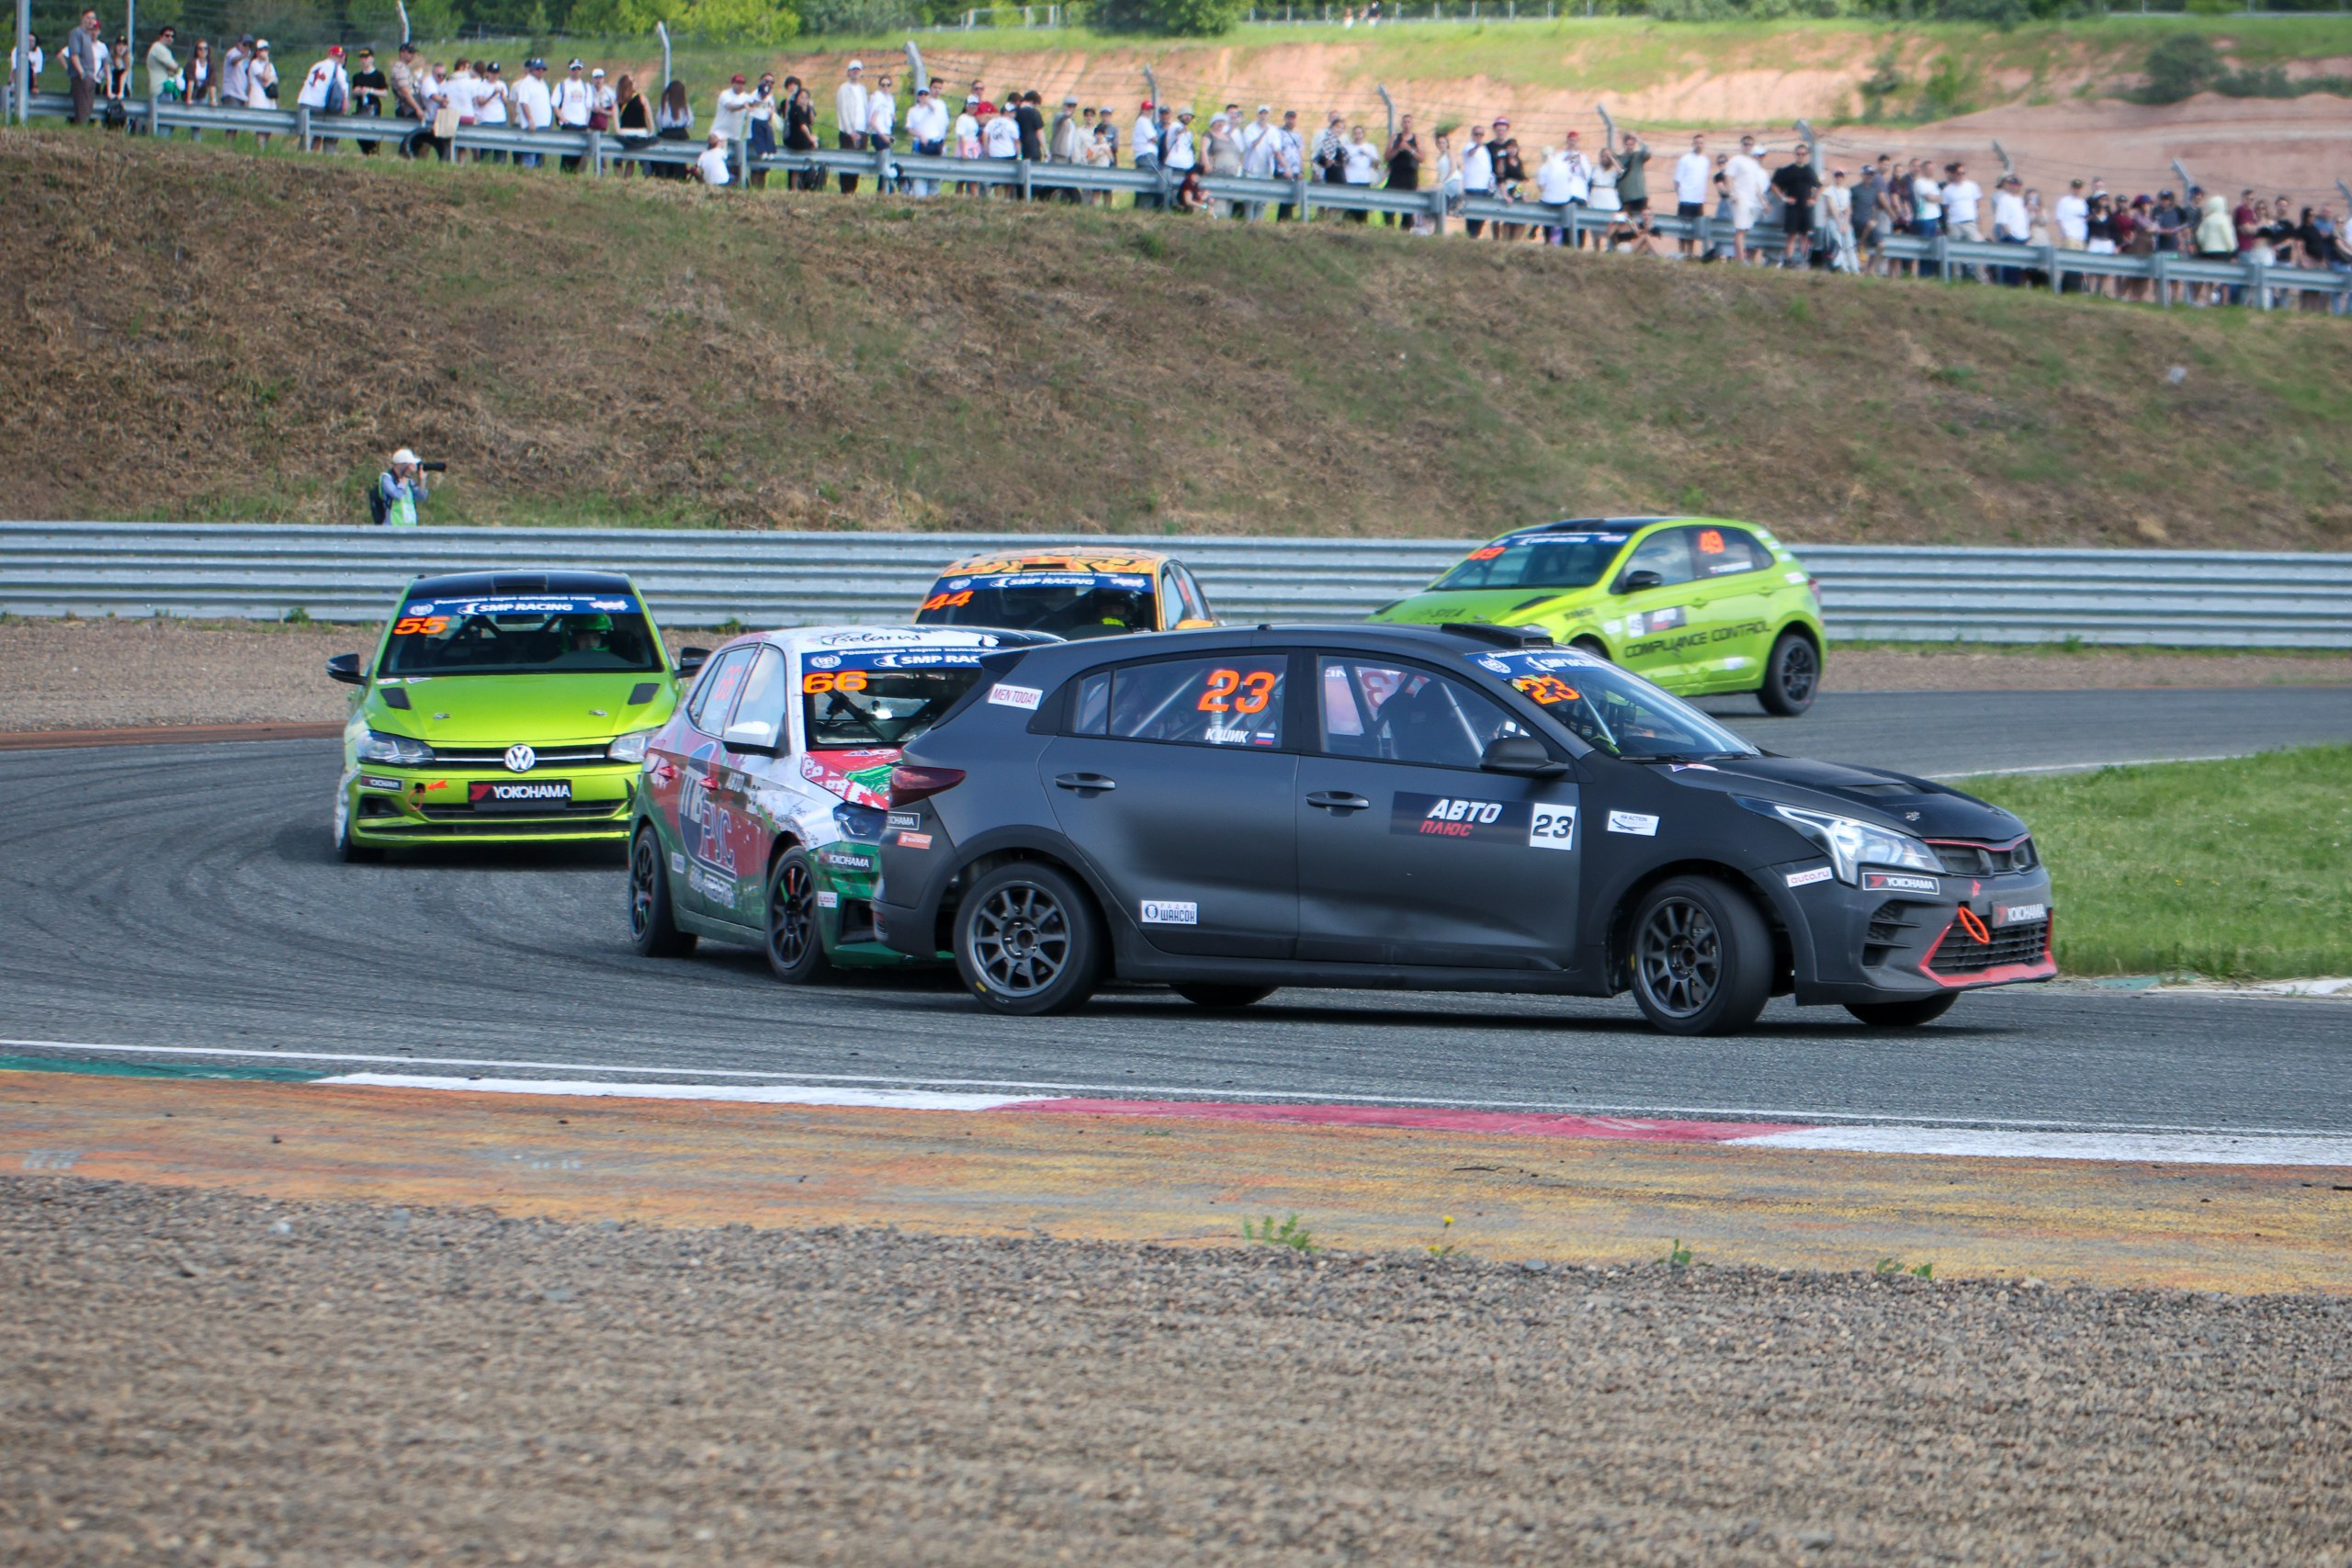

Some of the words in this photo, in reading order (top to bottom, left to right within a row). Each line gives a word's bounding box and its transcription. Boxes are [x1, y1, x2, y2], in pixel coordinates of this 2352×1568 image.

[479, 604, 514, 612] SMP
[922, 591, 975, 610] 44
[393, 616, 450, 635] 55
[1712, 621, 1771, 642] CONTROL
[901, 655, 944, 664] SMP
[945, 655, 980, 663] RAC
[803, 671, 868, 694] 66
[1518, 676, 1581, 705] 23
[993, 688, 1012, 701] MEN
[1012, 691, 1039, 705] TODAY
[1197, 670, 1276, 714] 23
[493, 785, 571, 799] YOKOHAMA
[1427, 798, 1503, 824] АВТО
[1419, 819, 1474, 837] ПЛЮС
[1532, 814, 1573, 839] 23
[829, 855, 869, 868] YOKOHAMA
[1792, 871, 1830, 884] auto.ru
[1886, 877, 1935, 890] YOKOHAMA
[1160, 909, 1195, 922] ШАНСОН
[2007, 904, 2046, 921] YOKOHAMA
